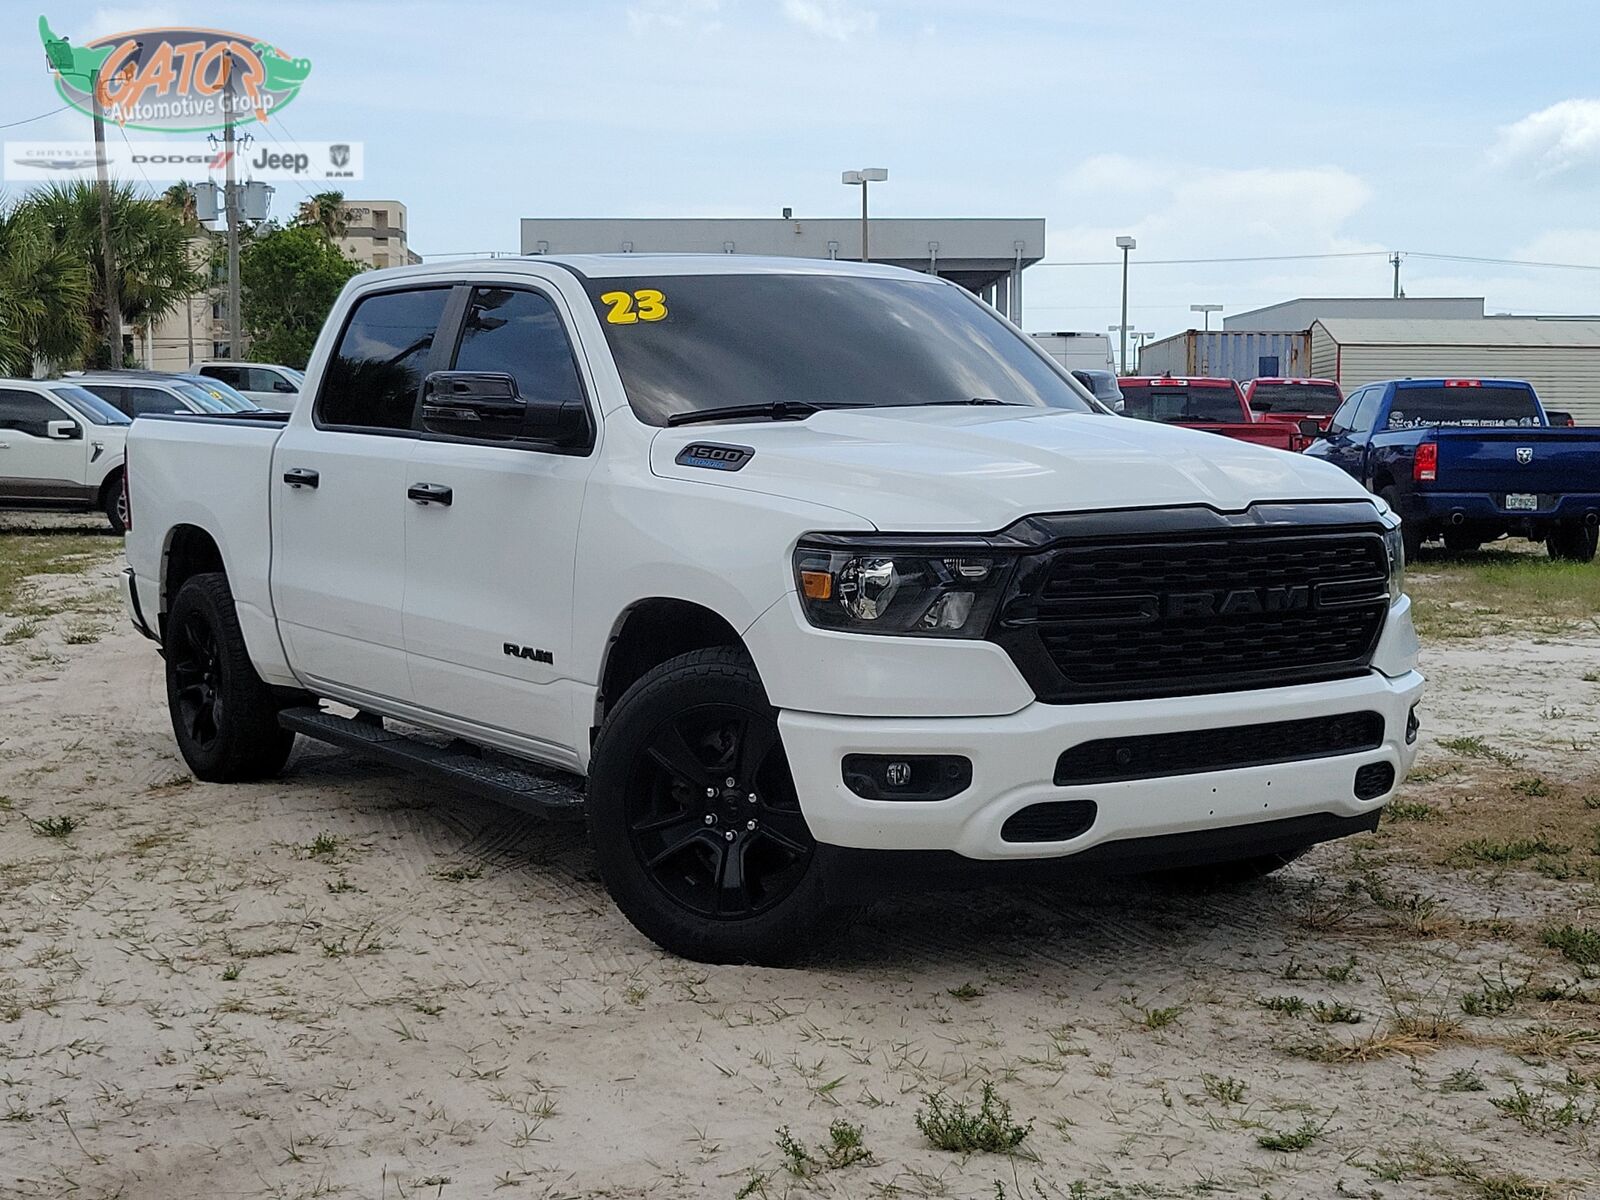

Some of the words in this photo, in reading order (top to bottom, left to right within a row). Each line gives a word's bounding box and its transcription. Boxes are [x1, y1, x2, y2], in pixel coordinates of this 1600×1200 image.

[601, 289, 668, 324] 23
[690, 447, 742, 461] 1500
[1168, 586, 1309, 616] RAM
[503, 643, 553, 665] RAM
